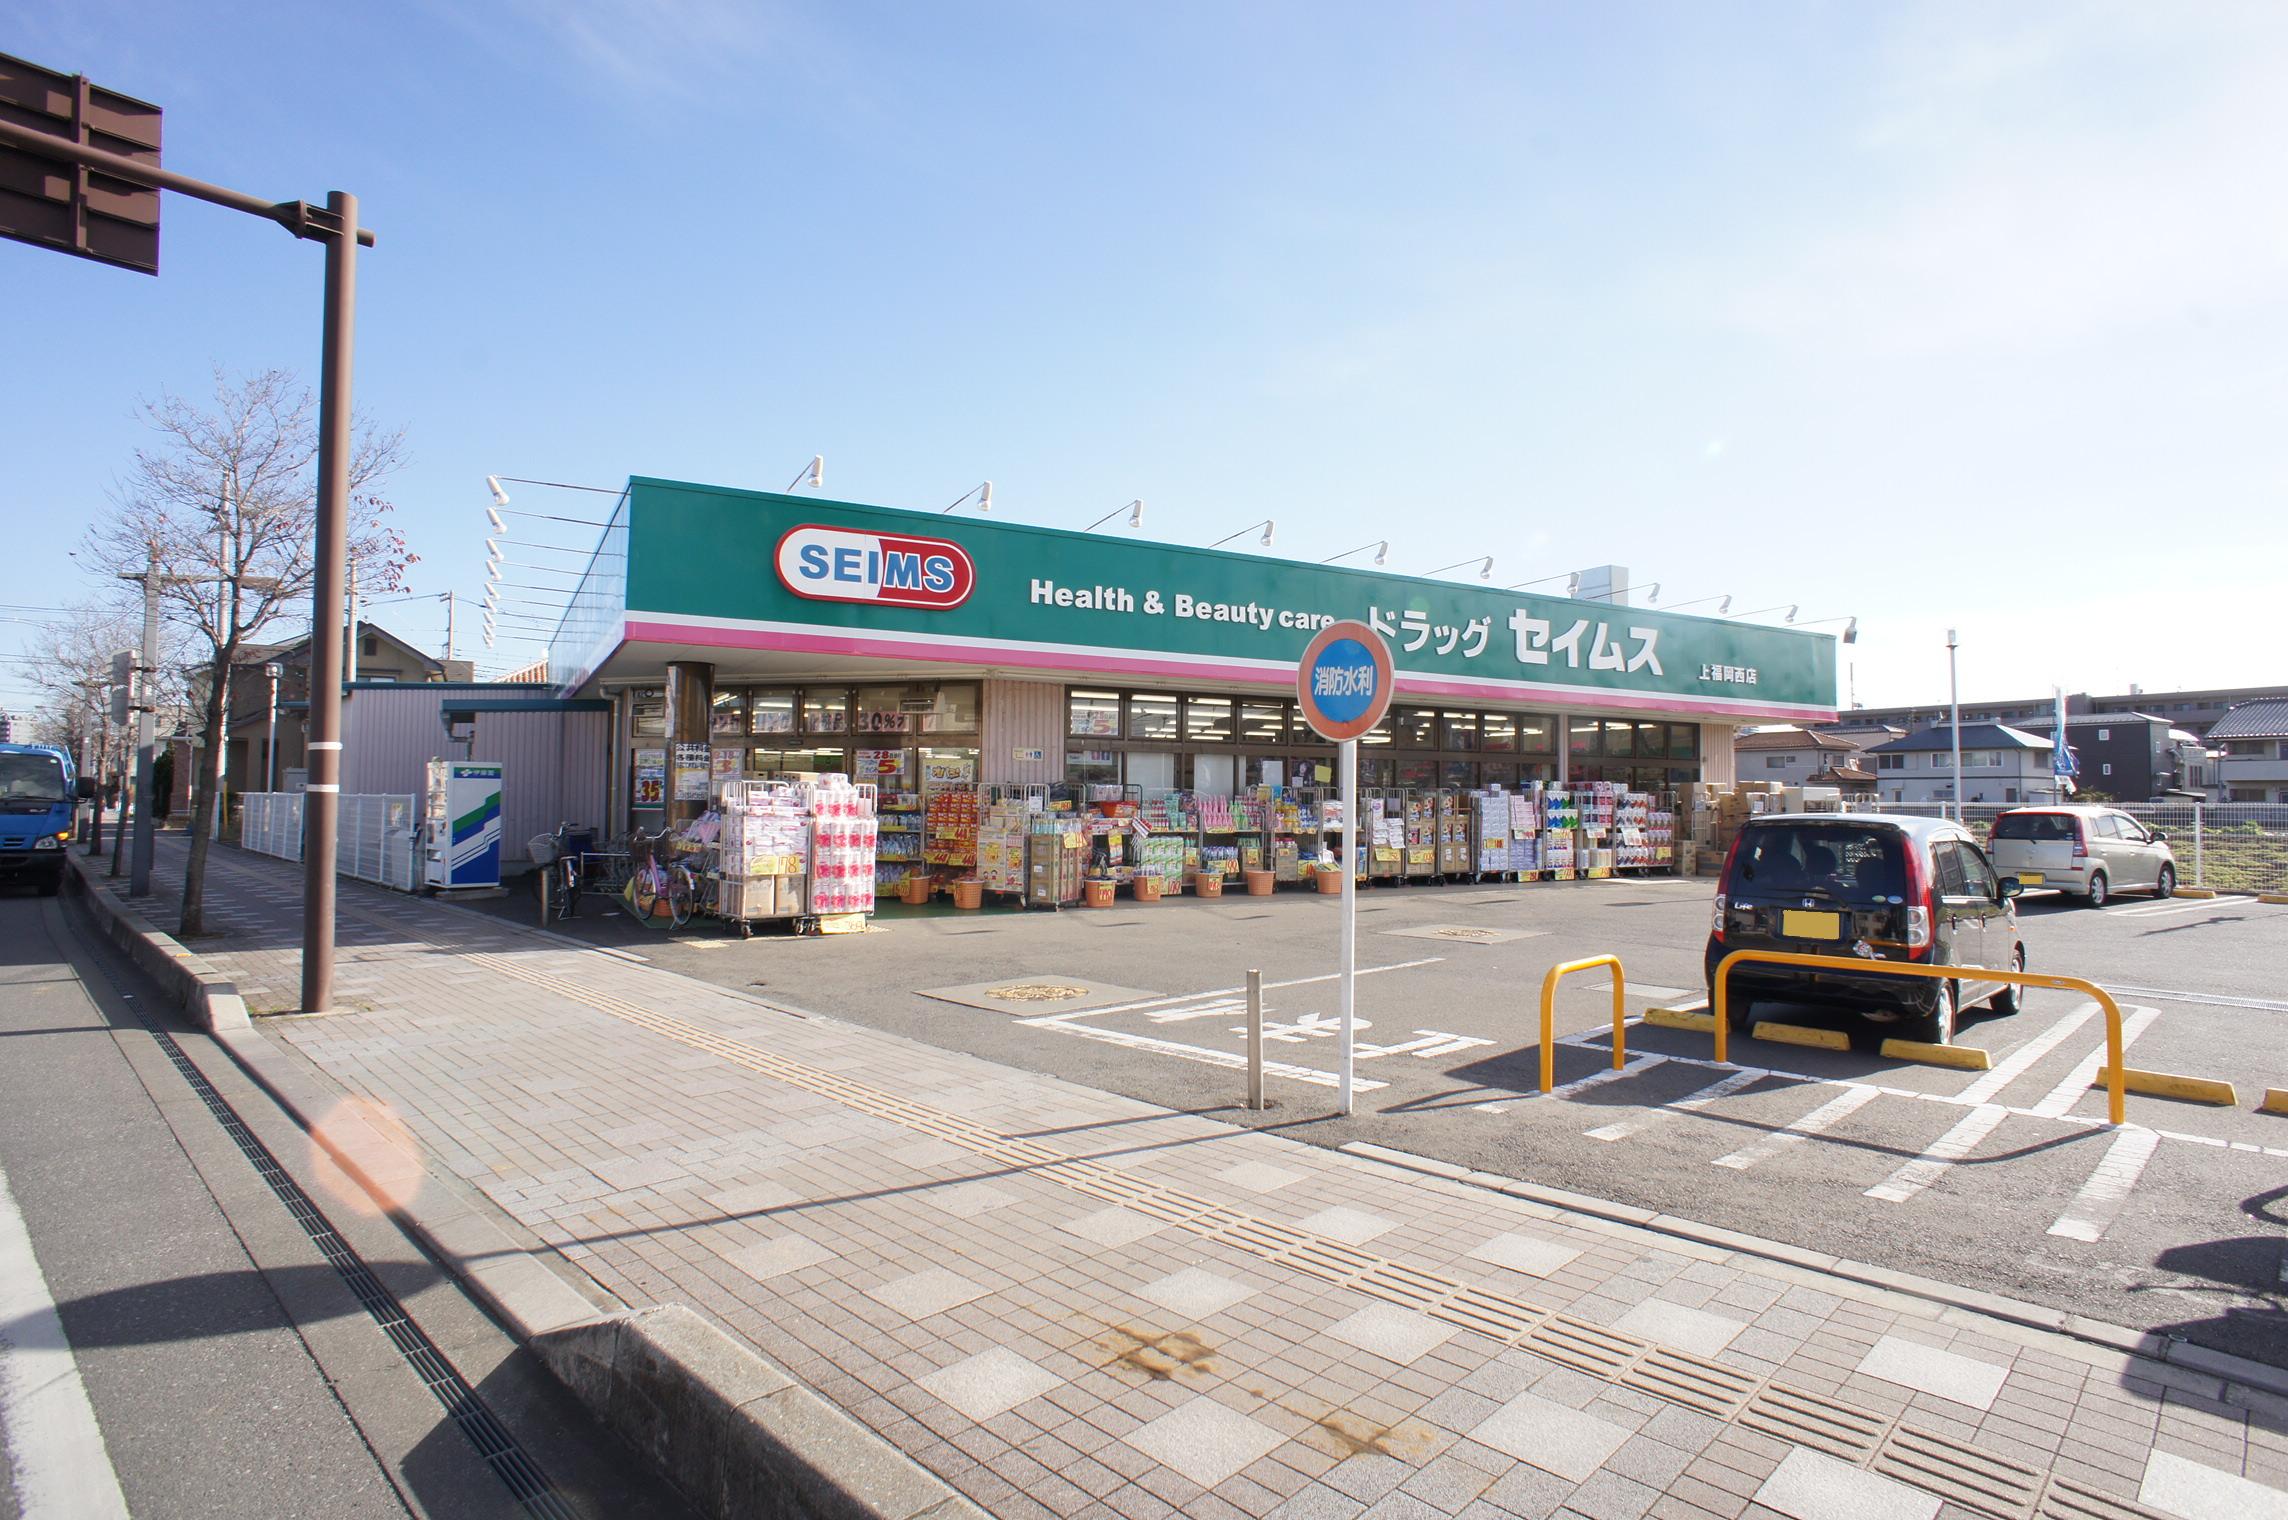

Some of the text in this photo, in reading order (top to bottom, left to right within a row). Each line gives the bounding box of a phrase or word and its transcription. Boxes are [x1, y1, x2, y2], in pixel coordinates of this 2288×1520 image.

[798, 544, 955, 593] SEIMS
[1030, 578, 1335, 632] Health & Beauty care
[1368, 606, 1664, 677] ドラッグ セイムス
[1313, 665, 1374, 697] 消防水利
[1697, 663, 1757, 686] 上福岡西店
